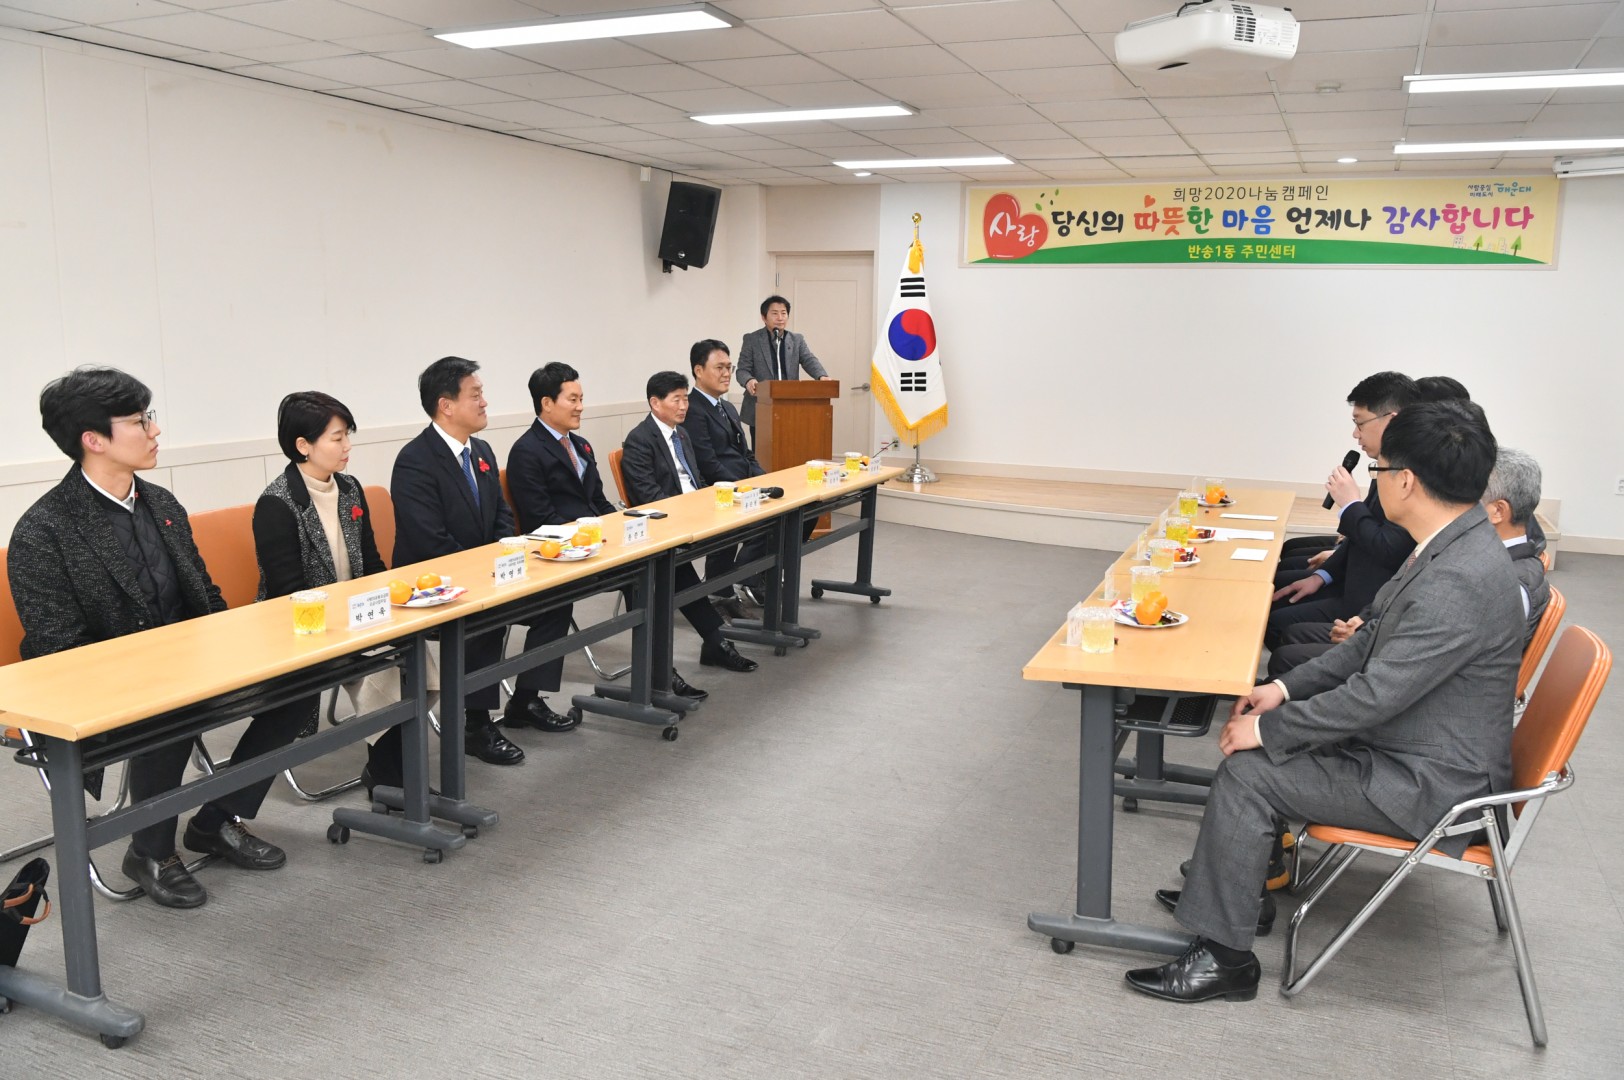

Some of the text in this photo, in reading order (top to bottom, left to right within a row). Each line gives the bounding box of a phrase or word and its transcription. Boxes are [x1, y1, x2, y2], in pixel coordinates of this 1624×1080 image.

[1173, 185, 1329, 202] 희망2020나눔캠페인
[1493, 181, 1532, 197] 해운대
[1051, 203, 1535, 237] 당신의 따뜻한 마음 언제나 감사합니다
[989, 211, 1040, 247] 사랑
[1187, 244, 1296, 260] 반송1동 주민센터
